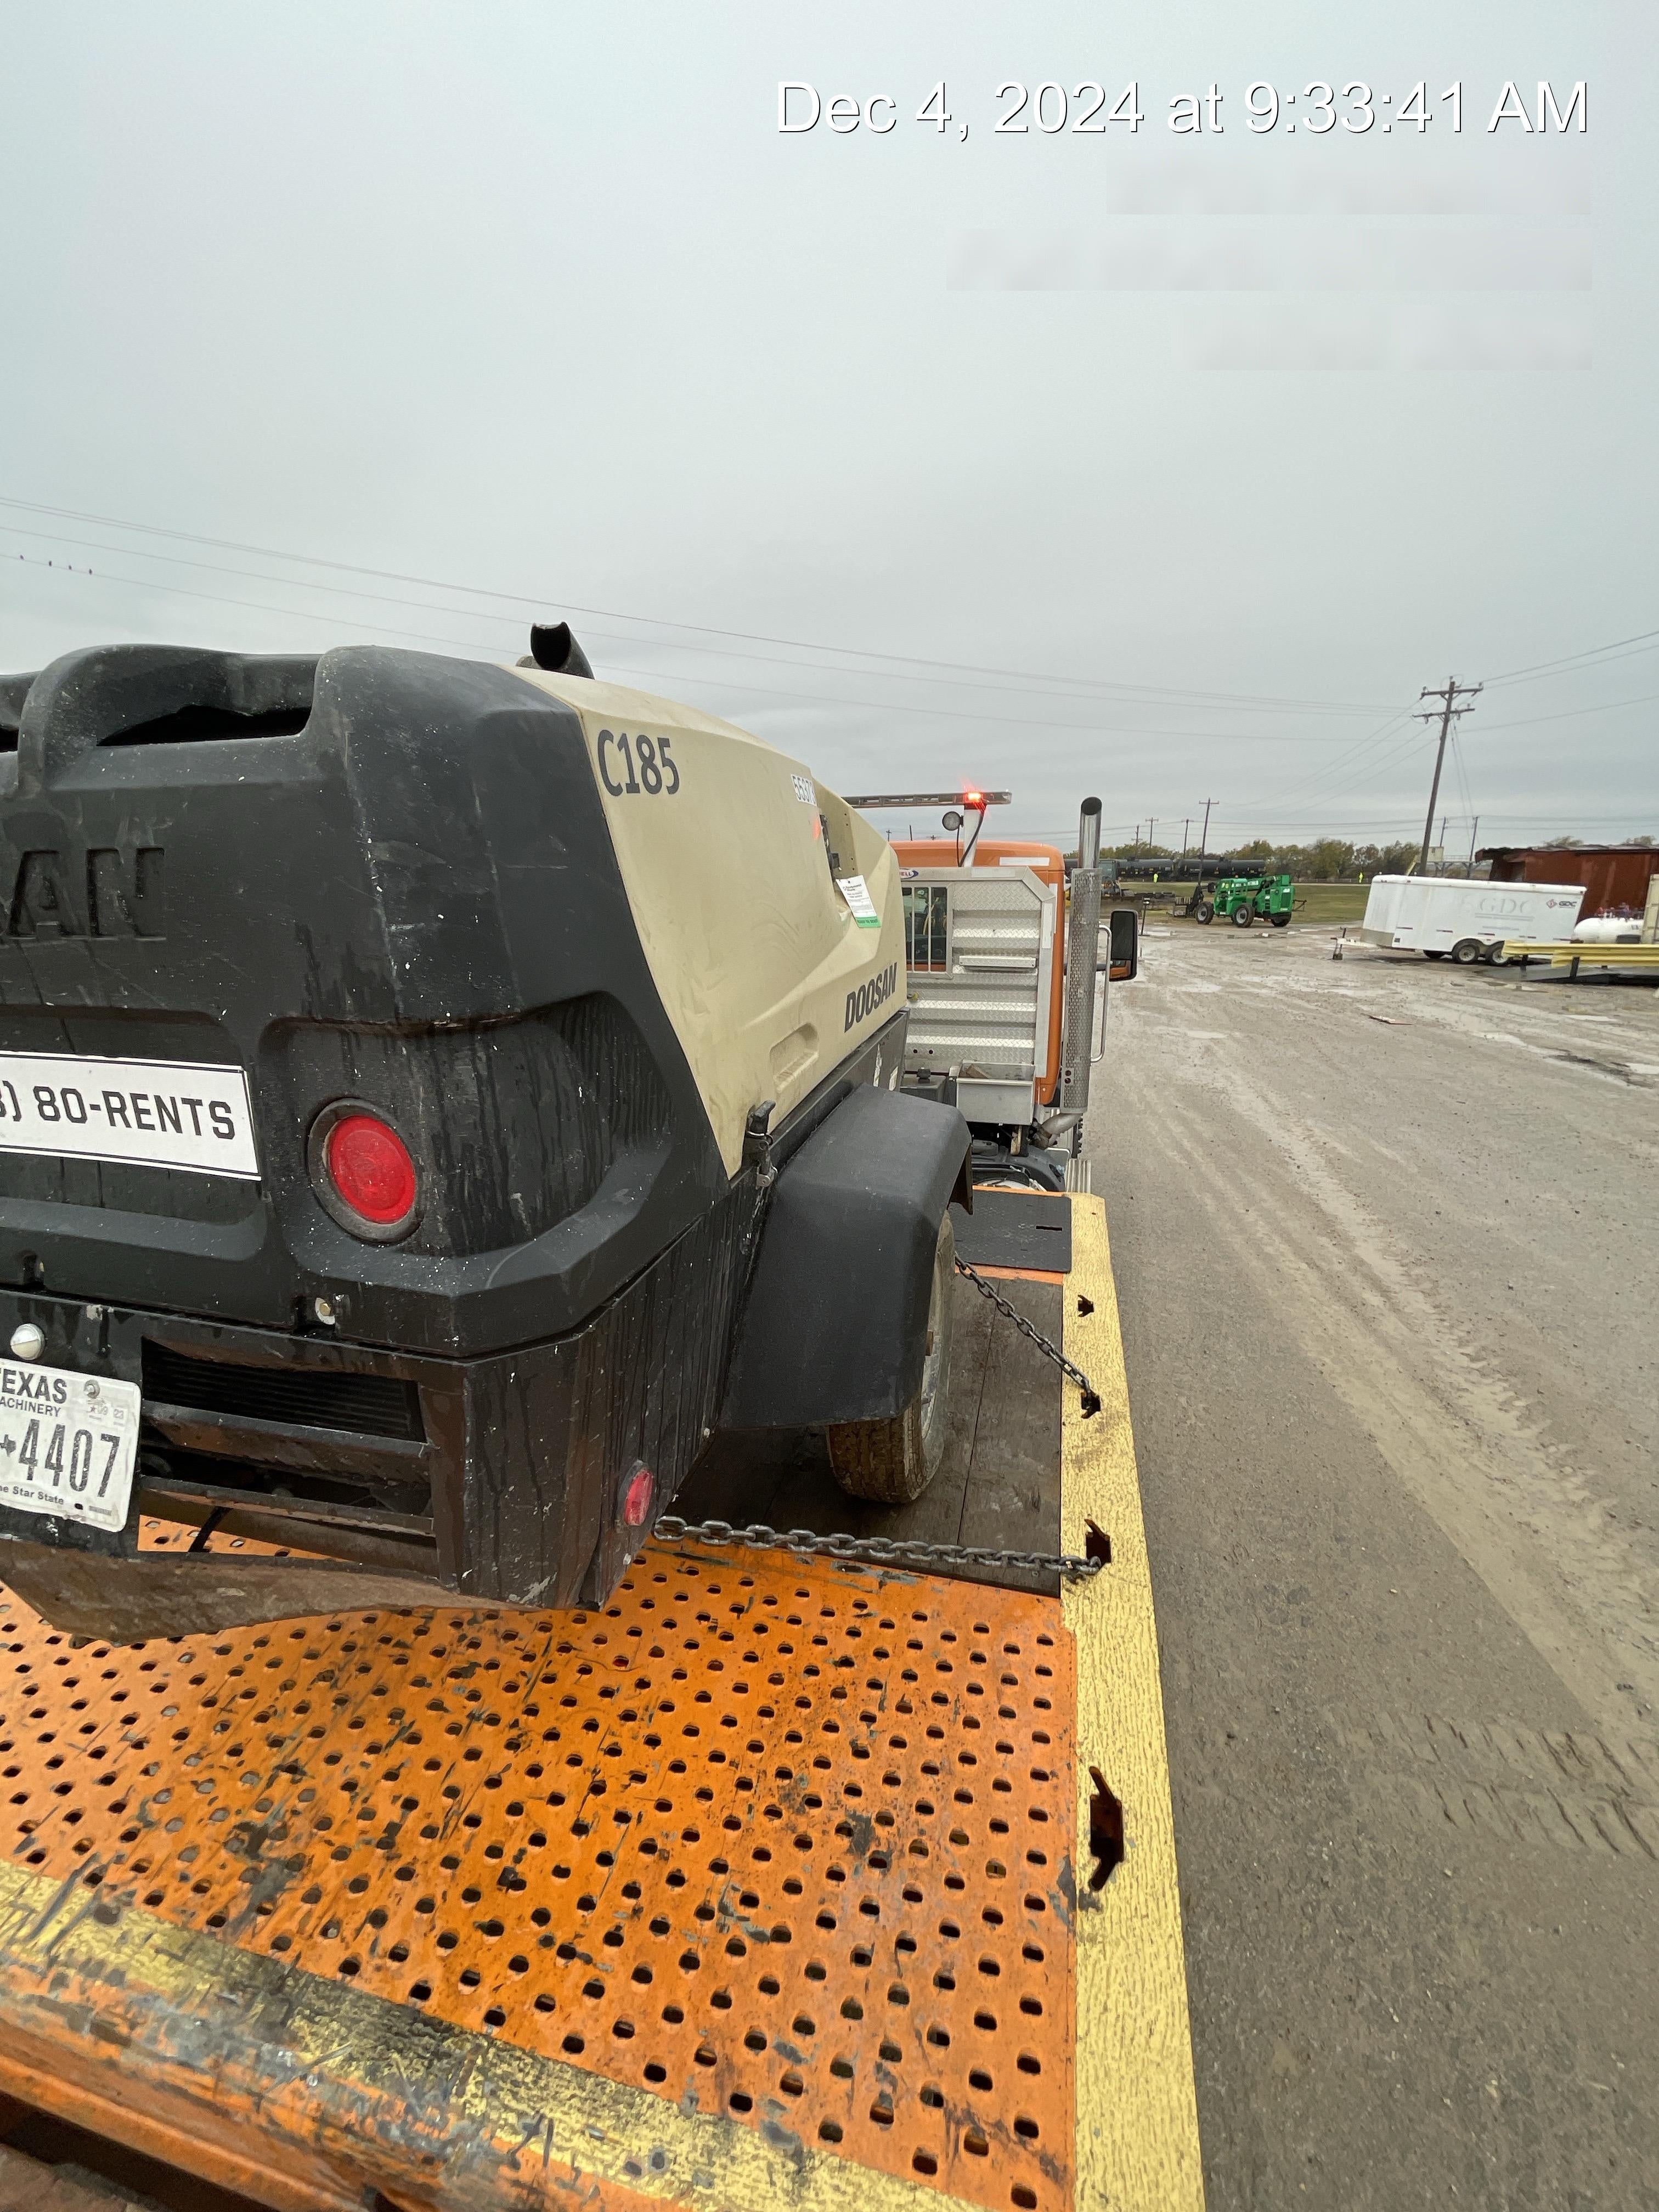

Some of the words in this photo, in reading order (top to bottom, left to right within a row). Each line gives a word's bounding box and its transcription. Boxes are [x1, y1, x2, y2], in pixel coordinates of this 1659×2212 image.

[597, 729, 680, 797] C185
[844, 962, 898, 1034] DOOSAN
[32, 1086, 235, 1140] 80-RENTS
[0, 1367, 67, 1404] EXAS
[19, 1419, 120, 1498] 4407
[13, 1486, 35, 1498] Star
[37, 1491, 64, 1505] State
